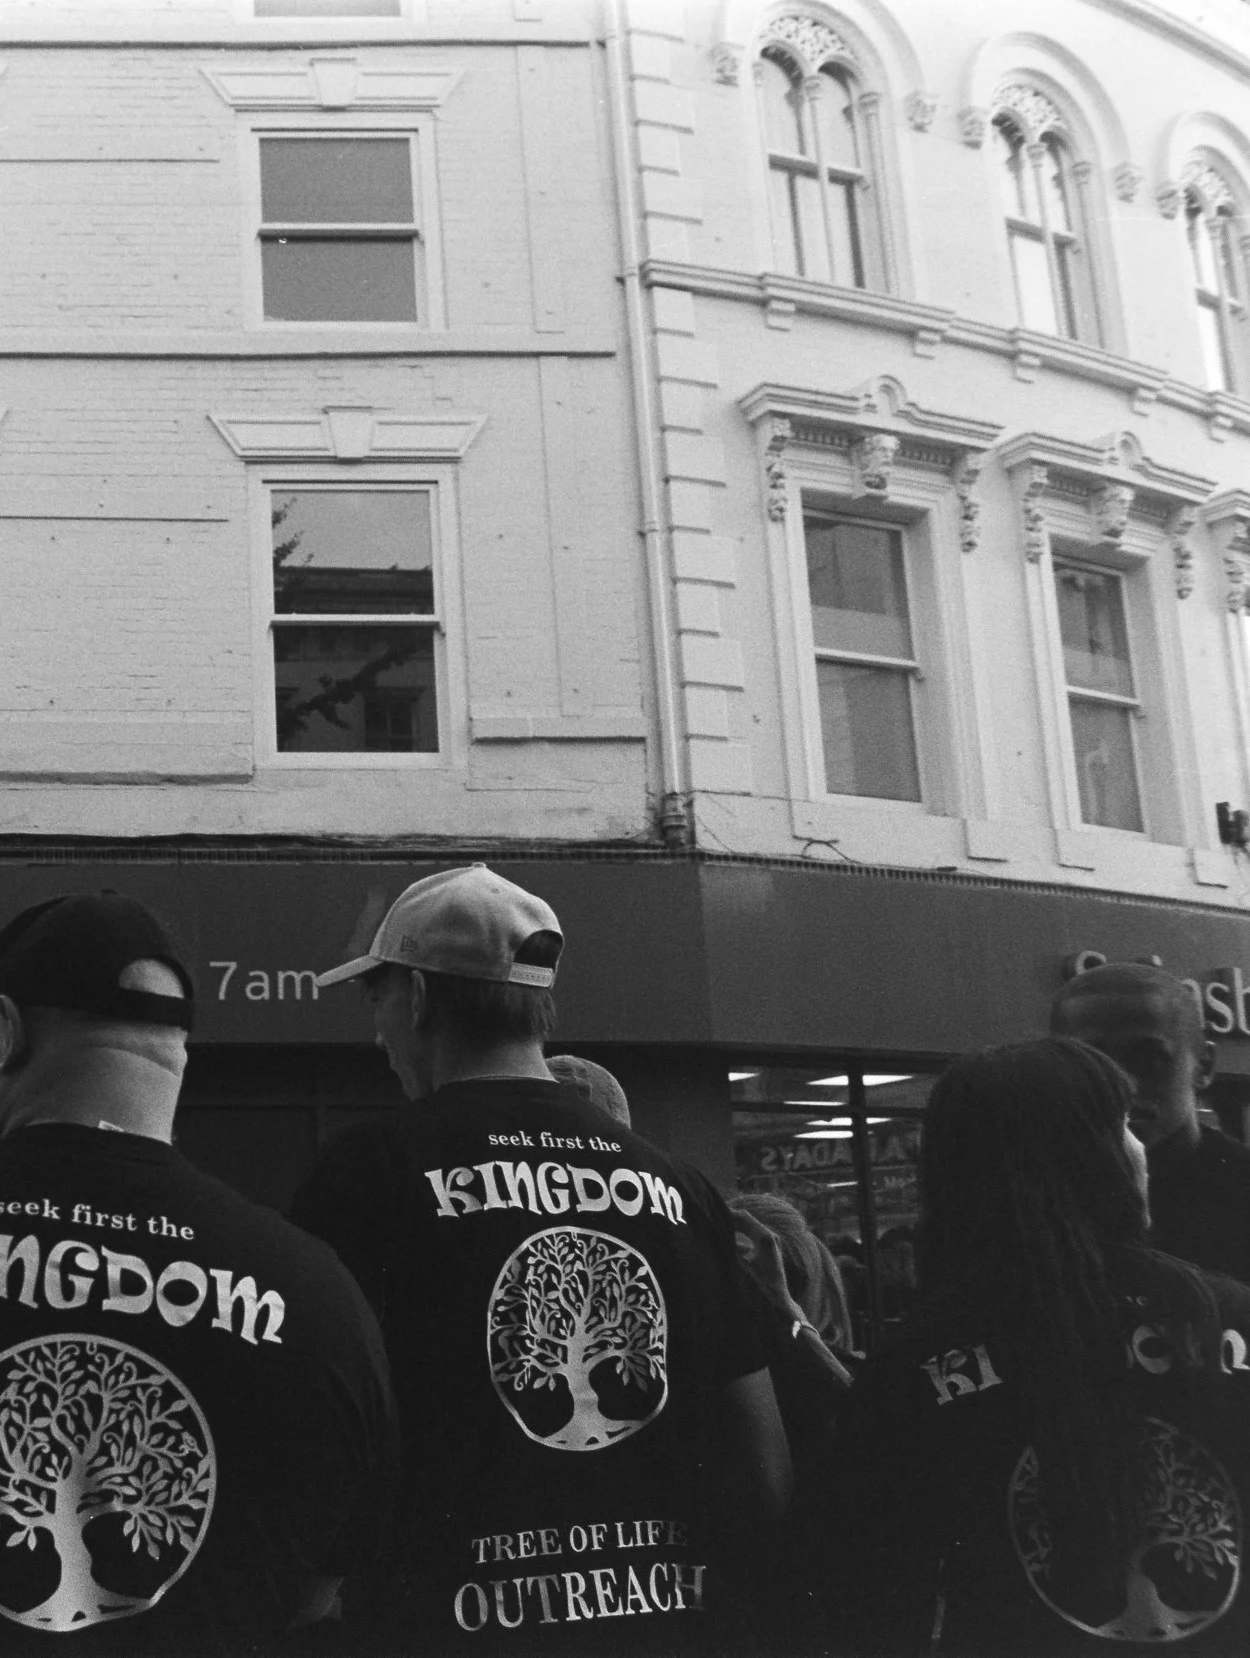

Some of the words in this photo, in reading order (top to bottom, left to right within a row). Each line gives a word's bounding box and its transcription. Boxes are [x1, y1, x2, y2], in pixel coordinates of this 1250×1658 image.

[209, 960, 320, 1001] 7am
[488, 1130, 535, 1147] seek
[539, 1131, 585, 1150] first
[588, 1136, 622, 1153] the
[424, 1160, 687, 1226] KINGDOM
[71, 1203, 137, 1232] first
[147, 1215, 195, 1241] the
[471, 1528, 563, 1564] TREE
[569, 1523, 608, 1553] OF
[614, 1520, 688, 1549] LIFE
[453, 1562, 707, 1632] OUTREACH
